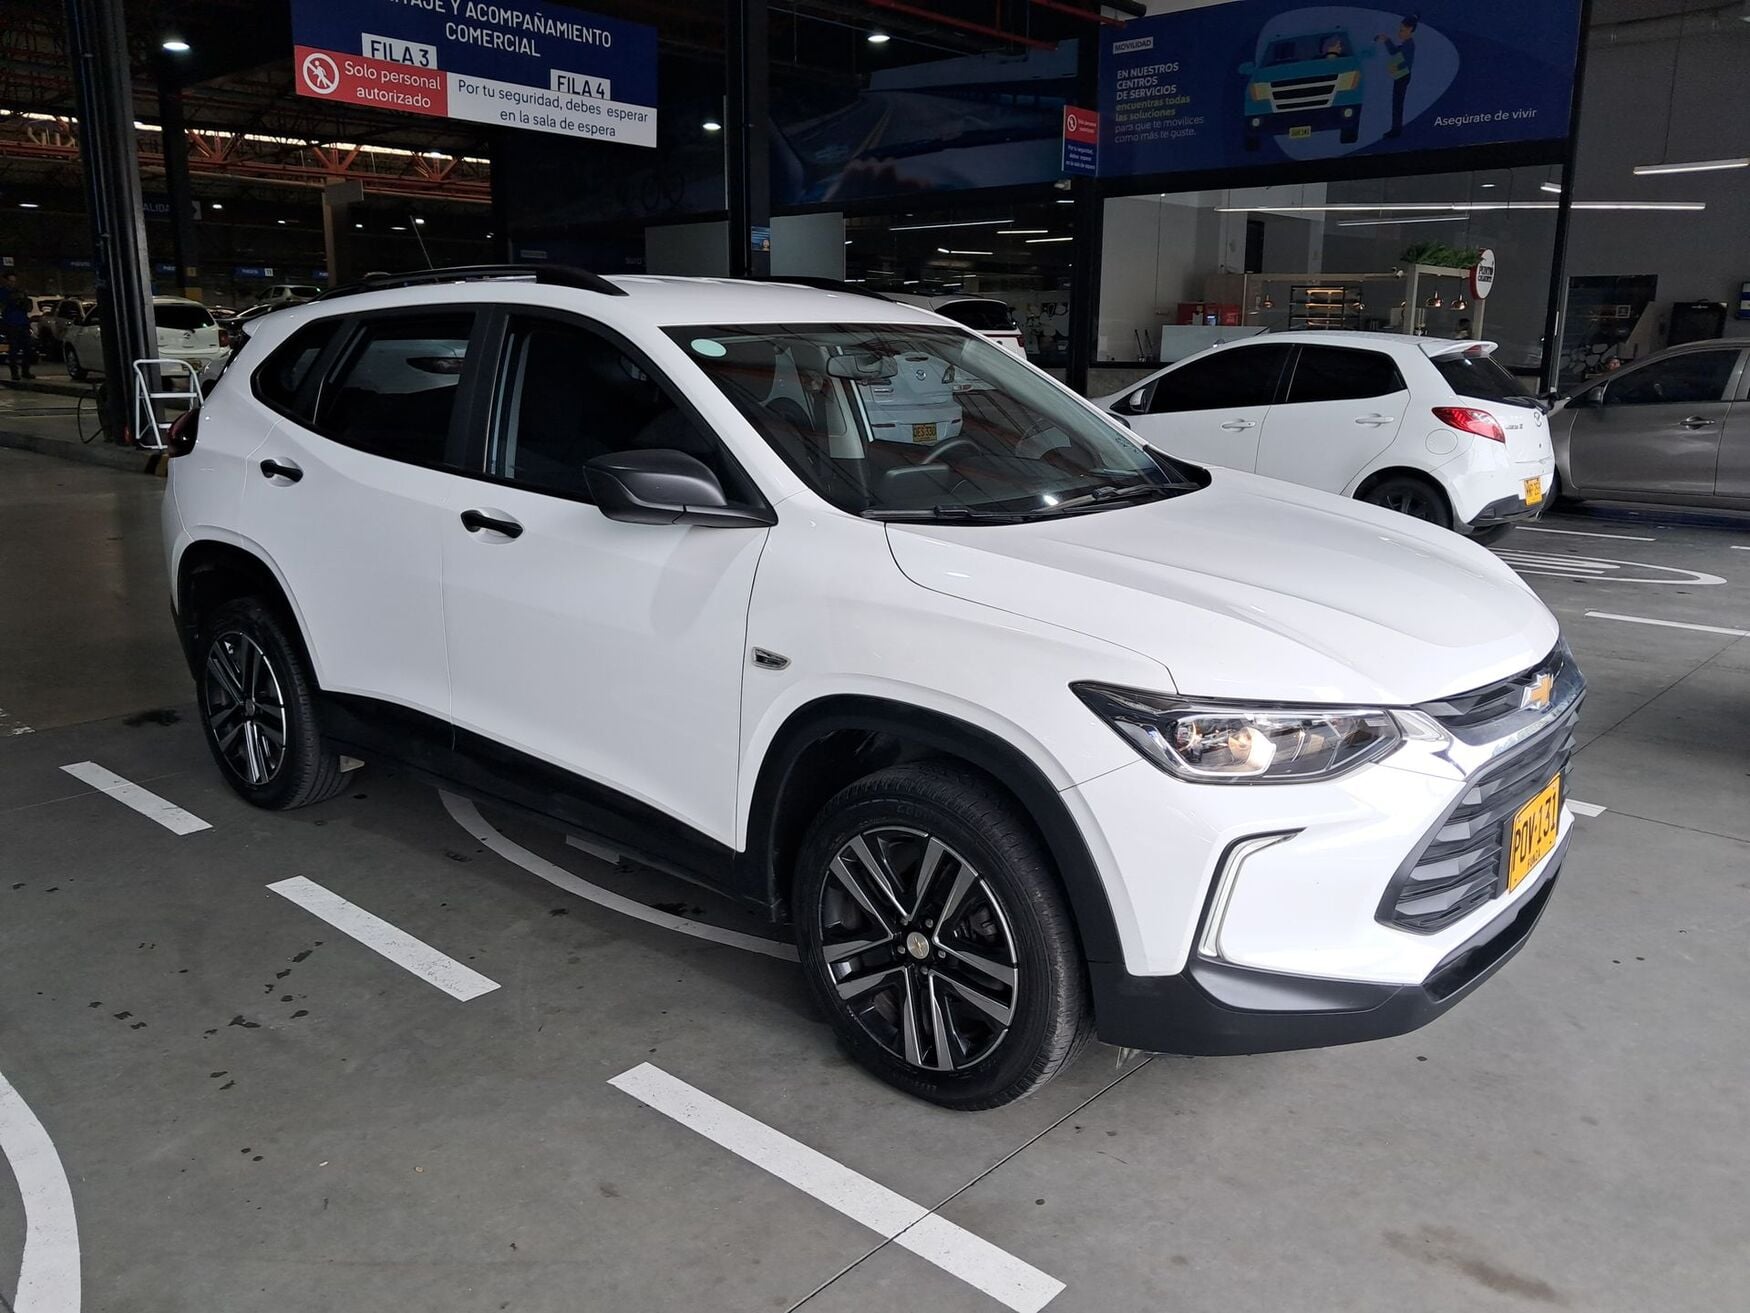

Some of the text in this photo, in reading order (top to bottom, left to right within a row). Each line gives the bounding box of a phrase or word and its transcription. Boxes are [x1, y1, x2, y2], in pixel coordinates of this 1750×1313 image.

[450, 0, 460, 15] Y
[465, 6, 612, 48] ACOMPAÑAMIENTO
[445, 22, 541, 57] COMERCIAL
[1114, 39, 1151, 51] MOVILIDAD
[370, 40, 430, 67] FILA 3
[344, 60, 441, 91] Solo personal
[1117, 62, 1180, 79] EN NUESTROS
[556, 75, 606, 98] FILA 4
[1116, 76, 1158, 90] CENTROS
[1116, 84, 1177, 100] DE SERVICIOS
[356, 86, 431, 108] autorizado
[458, 79, 648, 126] Por tu seguridad, debes esperar
[1115, 95, 1191, 111] encuentras todas
[1130, 108, 1176, 120] soluciones
[1434, 108, 1537, 127] Asegúrate de vivir
[500, 110, 616, 138] en la sala de espera
[1135, 122, 1151, 133] que
[1153, 120, 1162, 129] te
[1114, 133, 1139, 144] como
[1160, 130, 1169, 139] te
